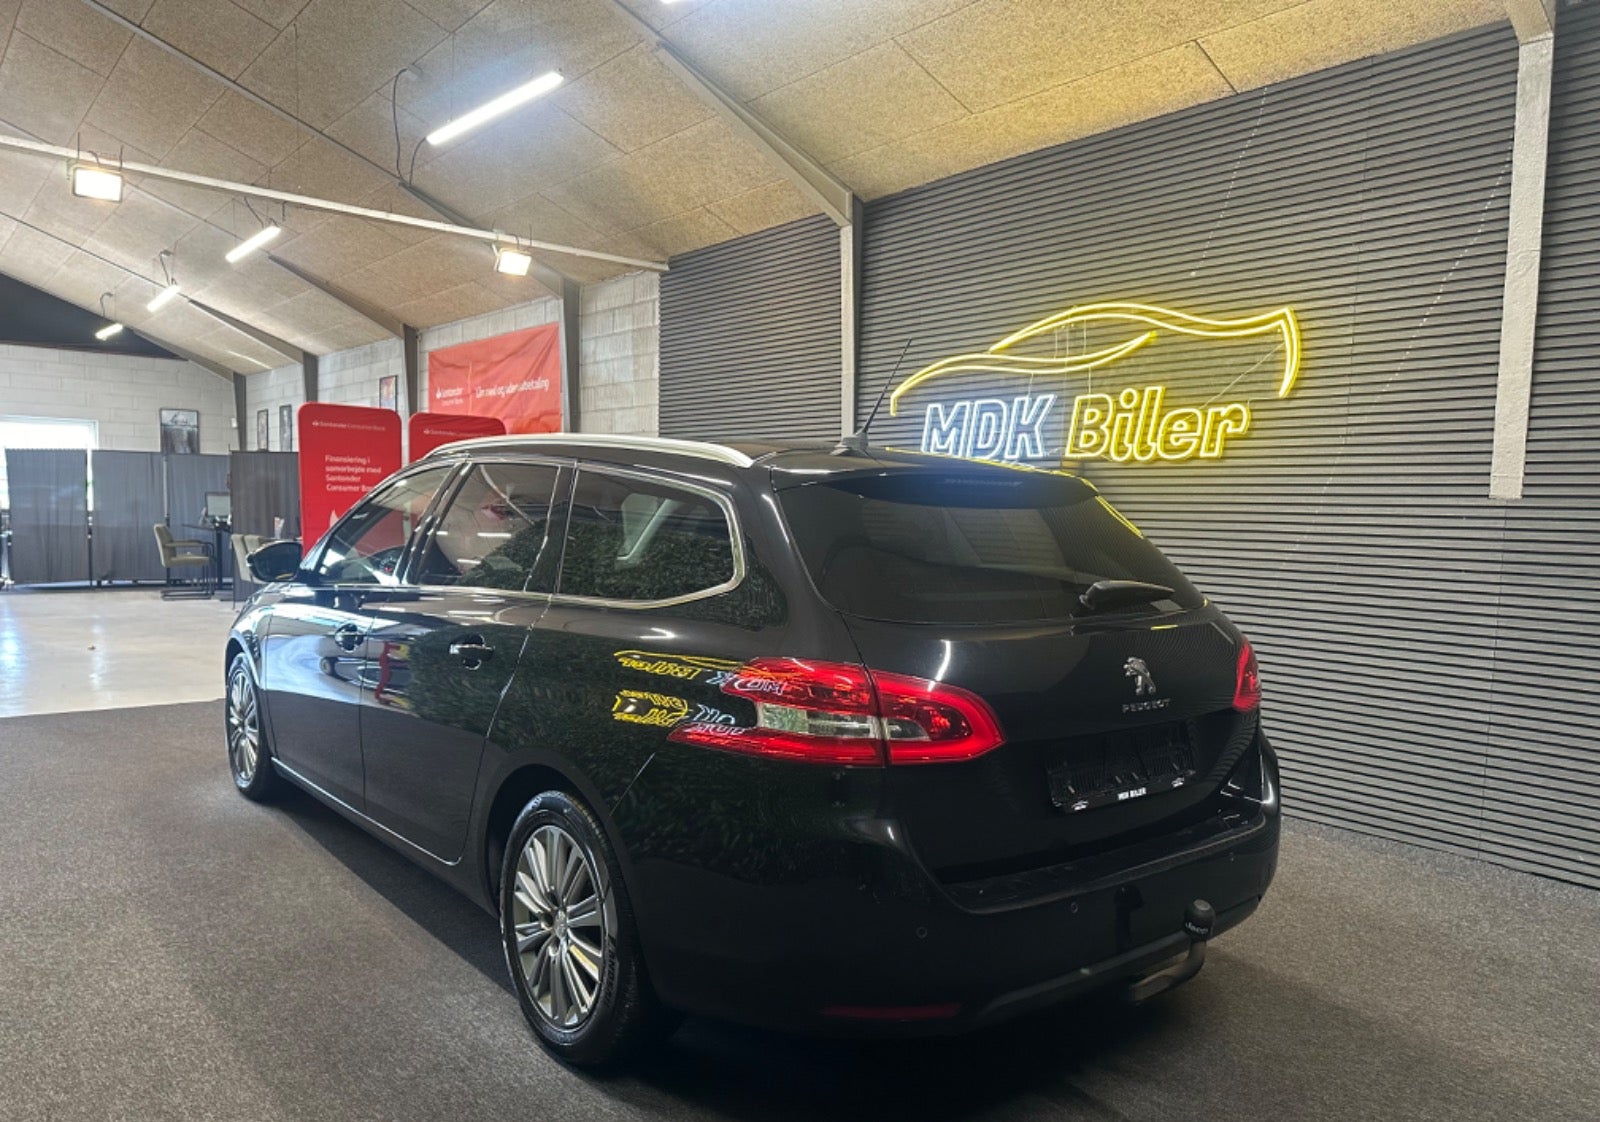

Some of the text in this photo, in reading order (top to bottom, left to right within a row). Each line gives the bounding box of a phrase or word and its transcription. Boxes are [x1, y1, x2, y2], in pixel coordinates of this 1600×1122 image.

[920, 386, 1250, 462] MDK Biler
[325, 454, 367, 465] Finansiering
[325, 465, 382, 474] samarbejde med
[325, 474, 361, 482] Santander
[326, 483, 360, 492] Consumer
[1122, 698, 1170, 713] PEUGEOT
